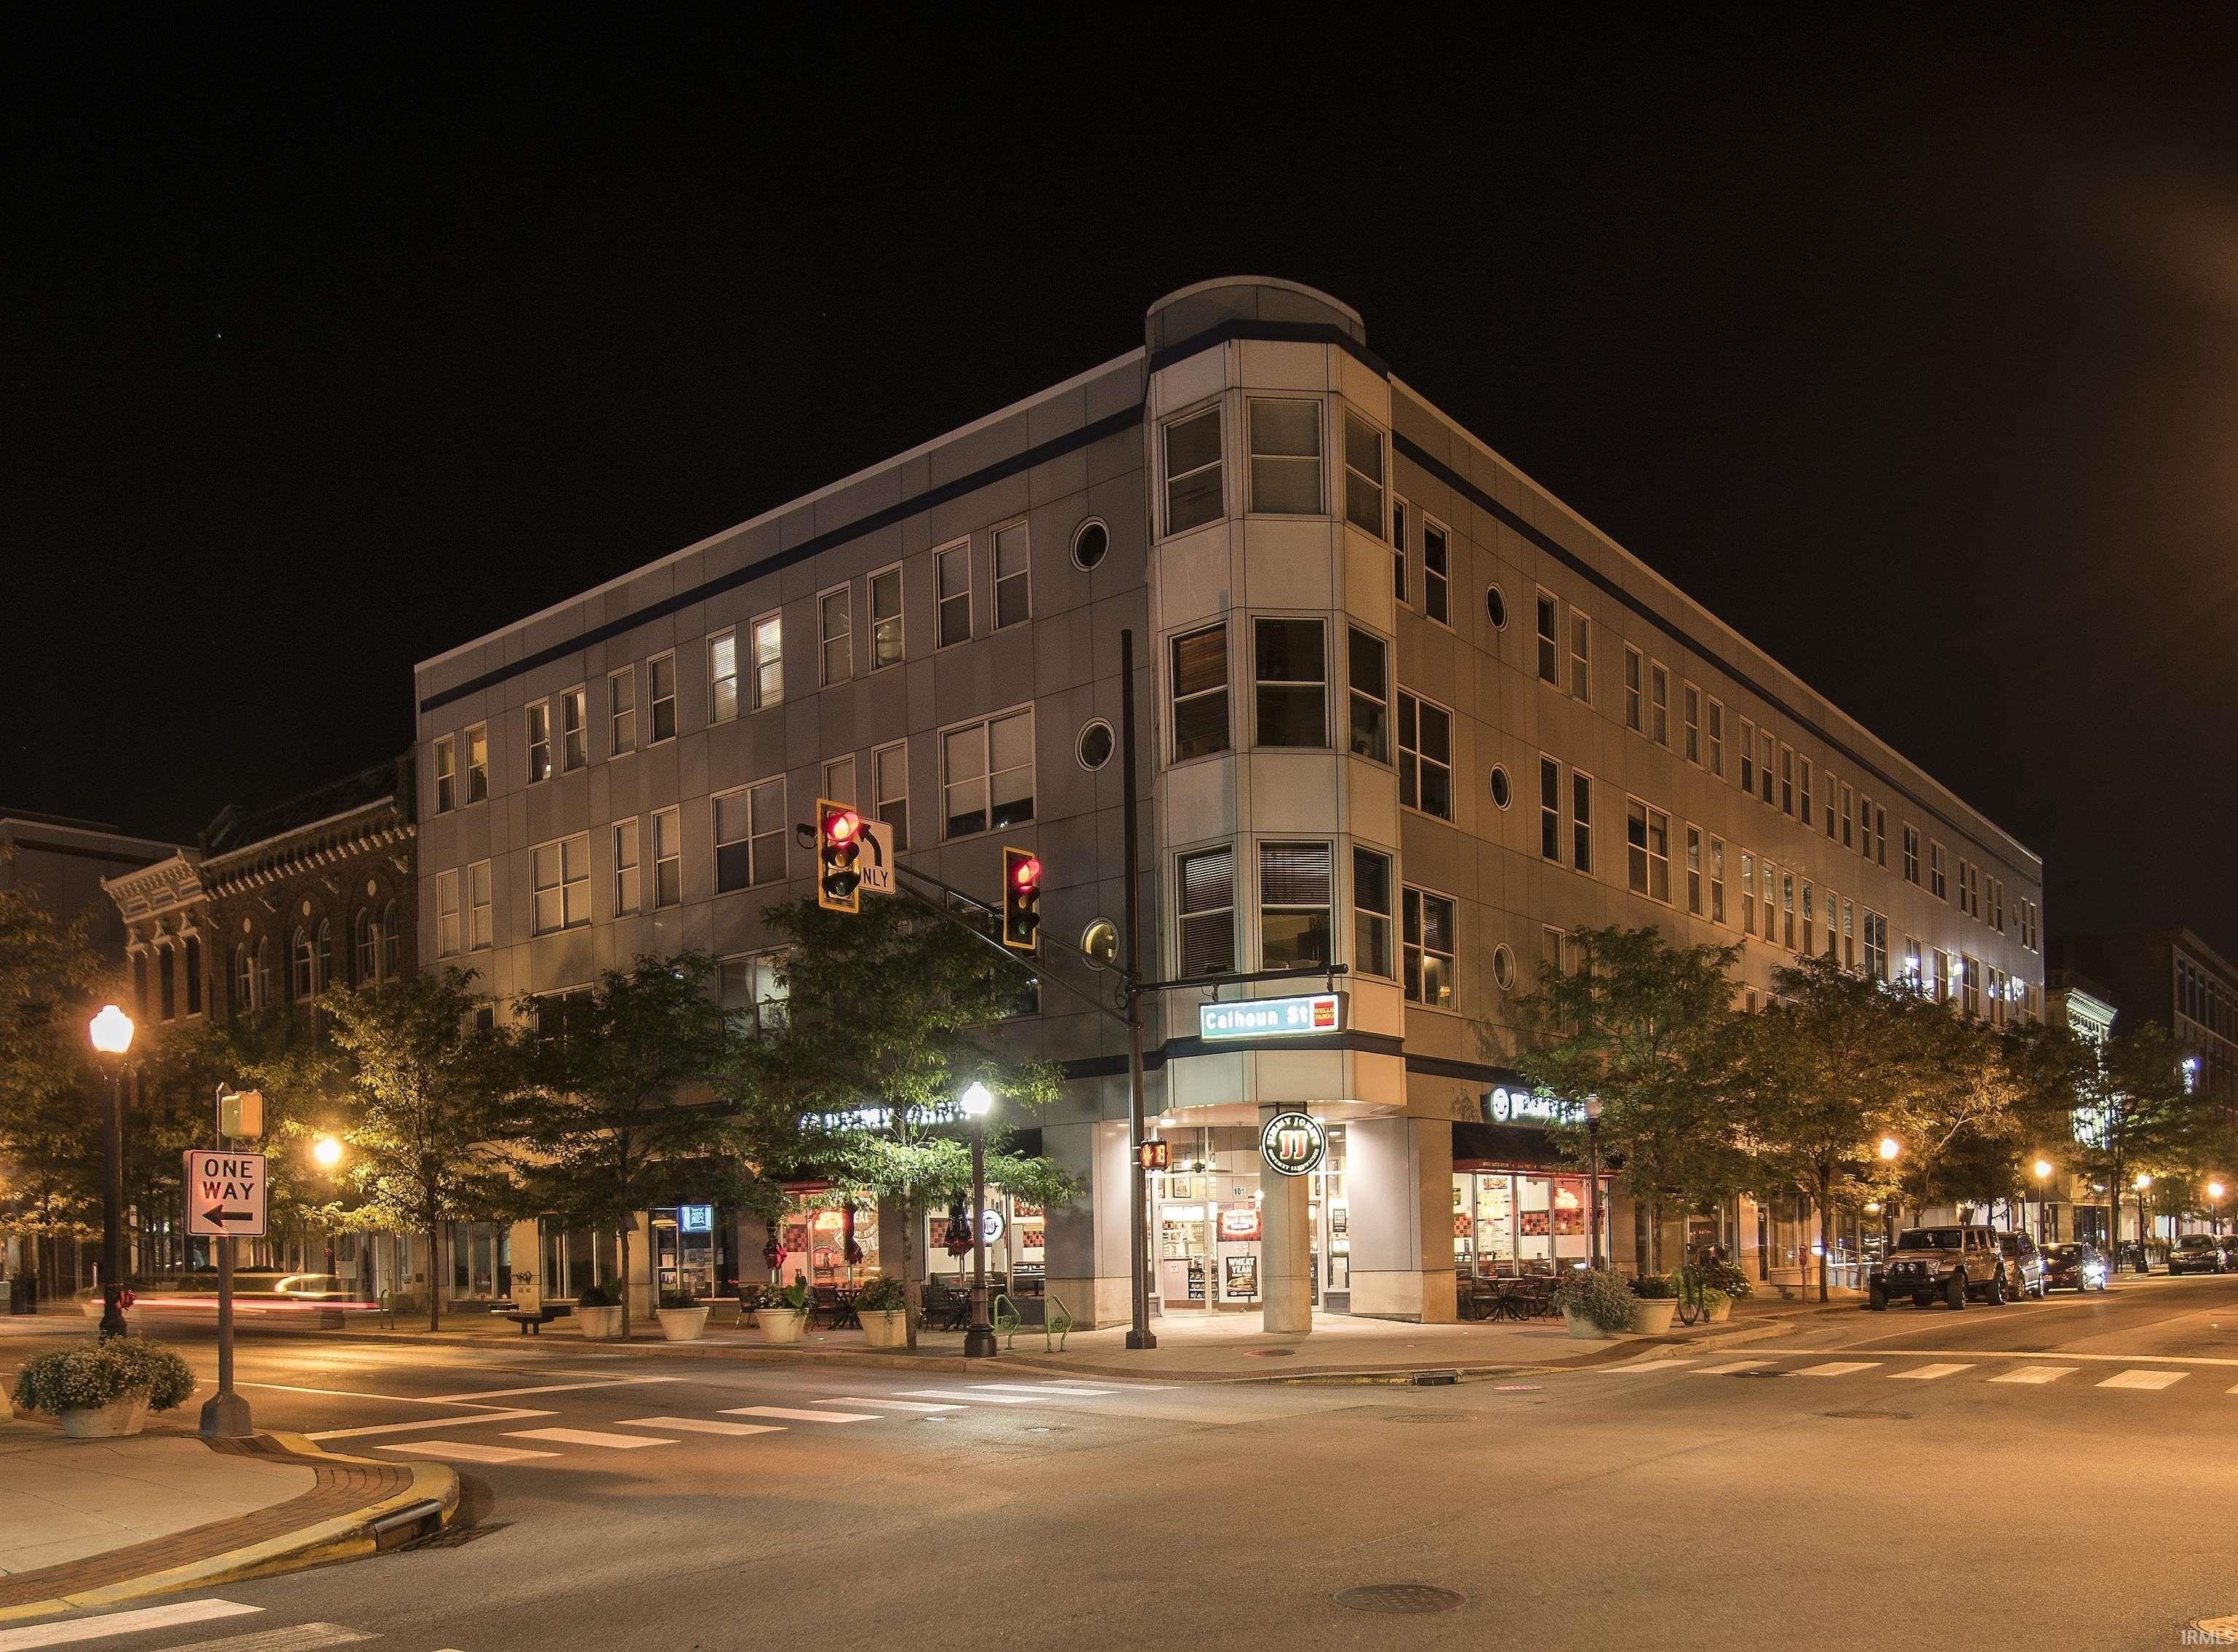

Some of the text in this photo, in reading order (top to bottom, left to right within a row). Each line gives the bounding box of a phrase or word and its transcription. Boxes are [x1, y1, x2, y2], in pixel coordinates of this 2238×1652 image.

[863, 867, 889, 888] NLY
[1206, 1005, 1308, 1029] Calhoun St
[1266, 1117, 1292, 1146] JIMMY
[1279, 1130, 1309, 1160] JJ
[205, 1158, 253, 1179] ONE
[203, 1181, 255, 1200] WAY
[1234, 1187, 1245, 1195] 101
[1228, 1257, 1255, 1267] WHEAT
[1231, 1265, 1252, 1273] YEAH
